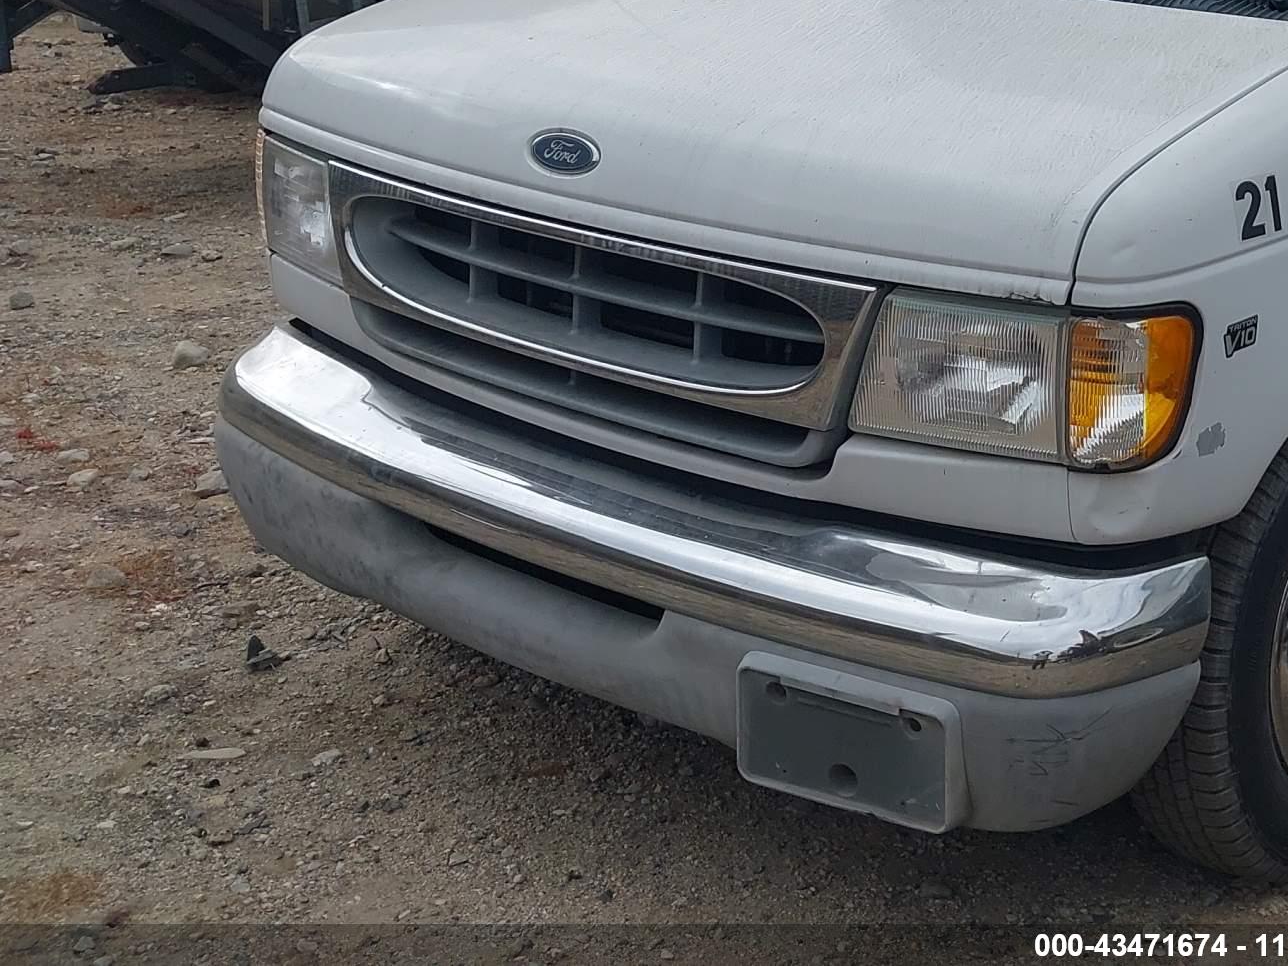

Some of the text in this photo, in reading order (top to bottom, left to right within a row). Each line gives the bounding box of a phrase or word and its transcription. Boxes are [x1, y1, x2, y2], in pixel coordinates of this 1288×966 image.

[544, 139, 581, 164] Ford
[1235, 175, 1282, 241] 21
[1228, 317, 1257, 332] TRITON
[1224, 327, 1257, 358] V10
